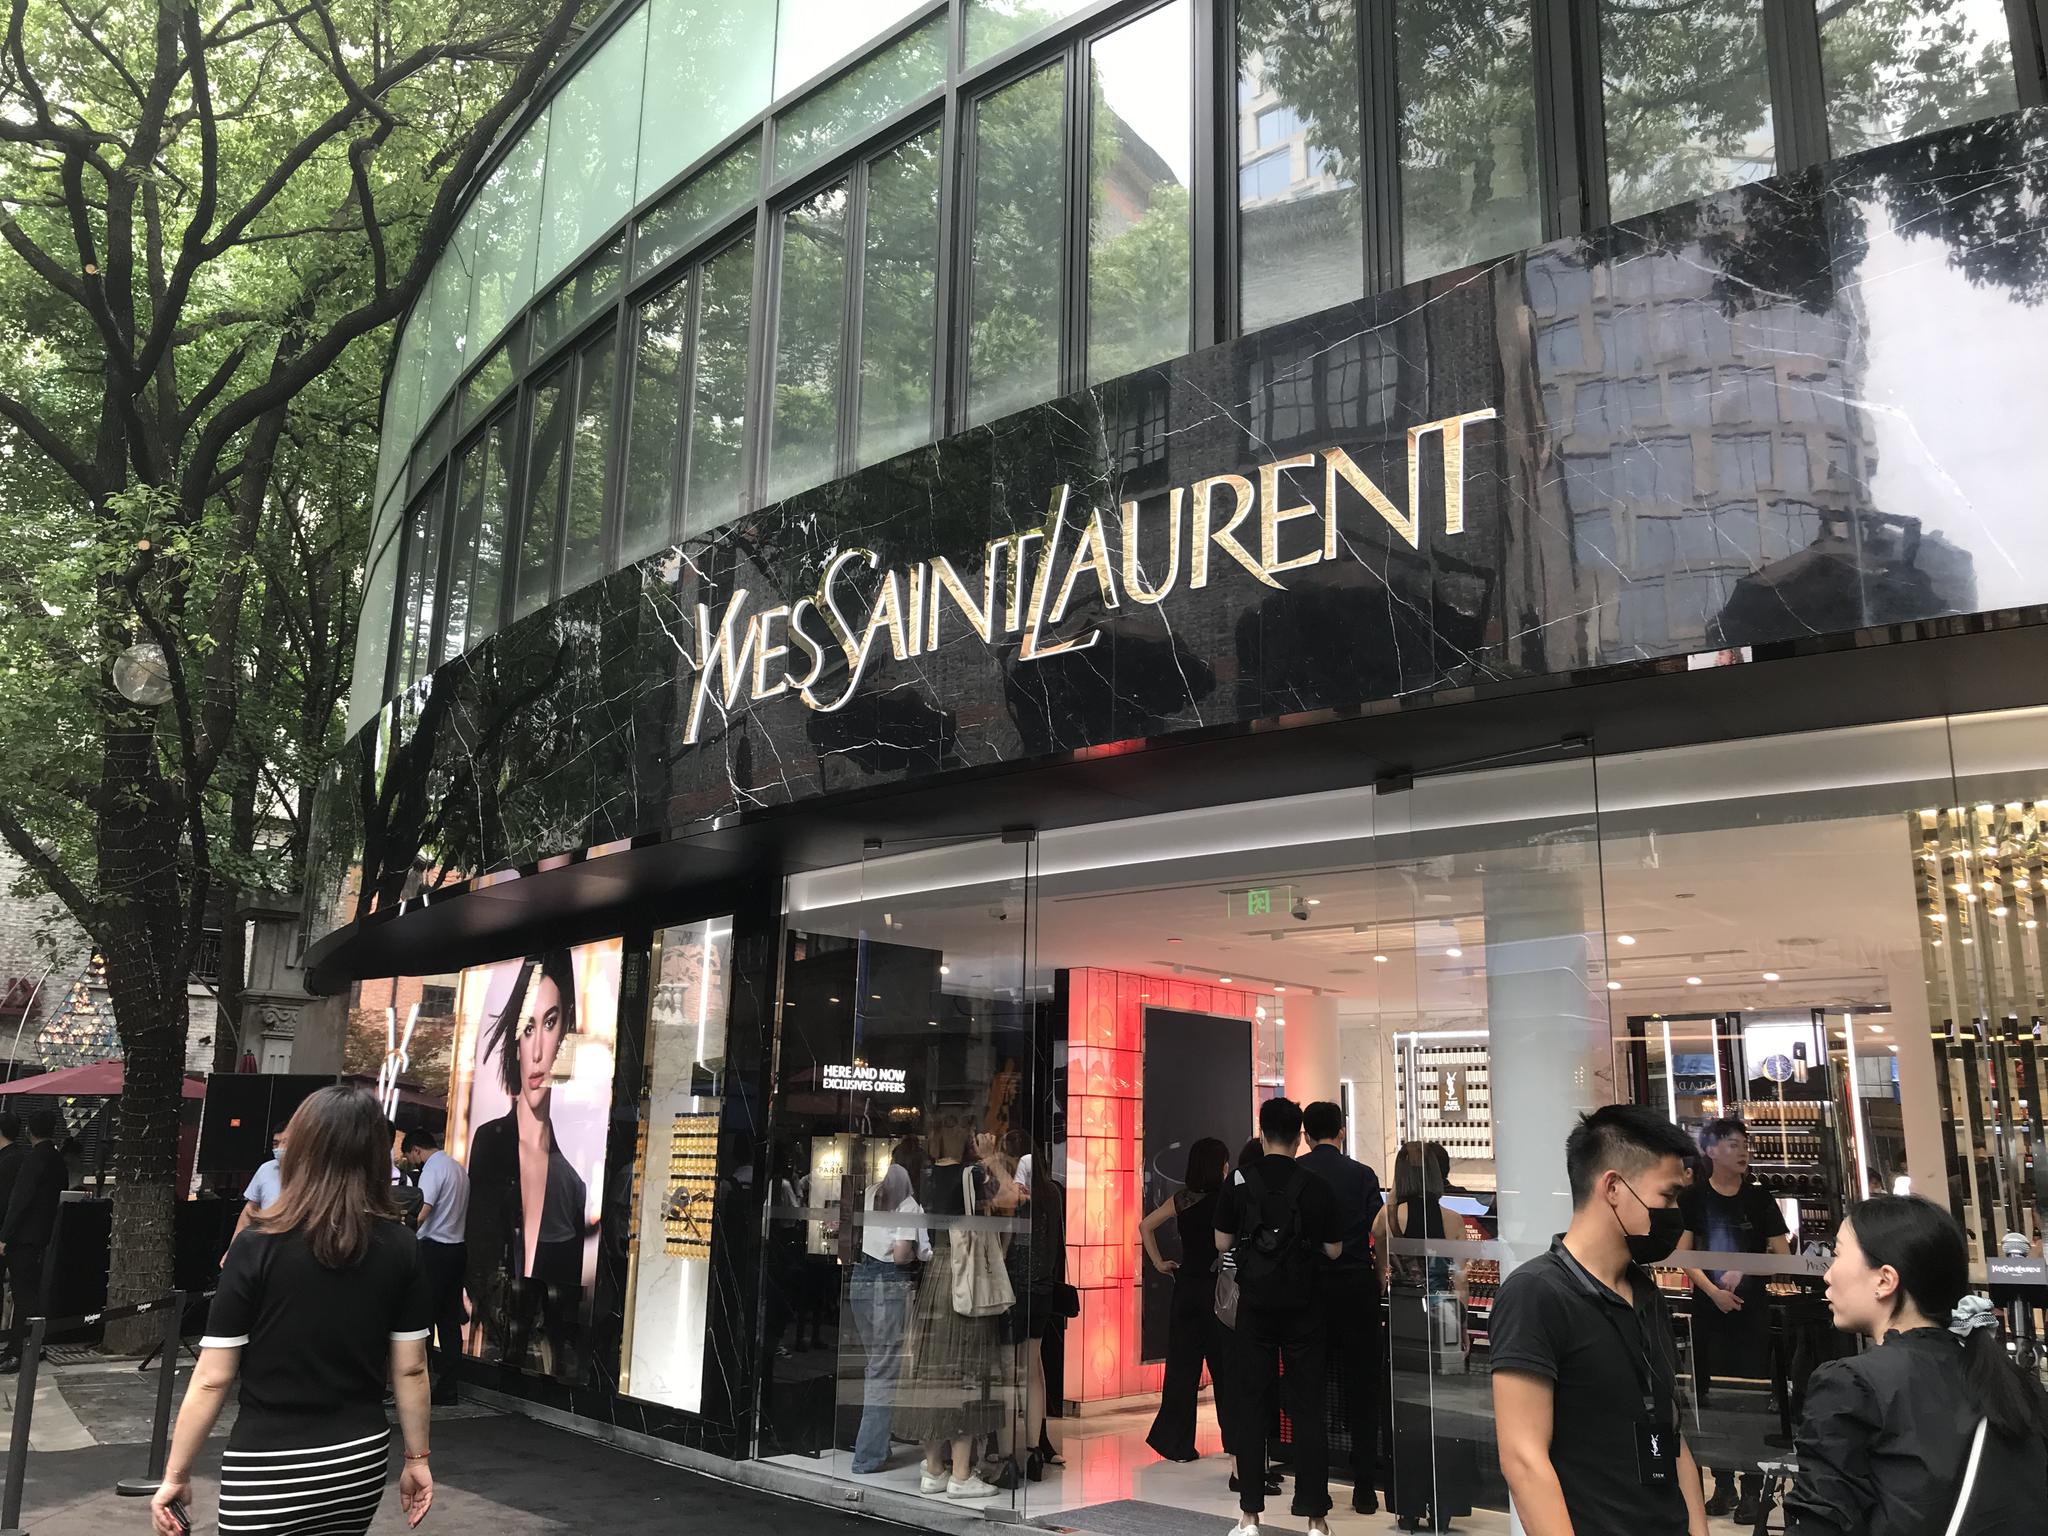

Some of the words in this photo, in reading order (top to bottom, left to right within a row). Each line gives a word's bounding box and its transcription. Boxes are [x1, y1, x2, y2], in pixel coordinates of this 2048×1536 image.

[823, 1065, 852, 1078] HERE
[853, 1067, 877, 1080] AND
[879, 1069, 906, 1082] NOW
[823, 1078, 873, 1091] EXCLUSIVES
[874, 1081, 906, 1093] OFFERS
[818, 1166, 844, 1174] PARIS
